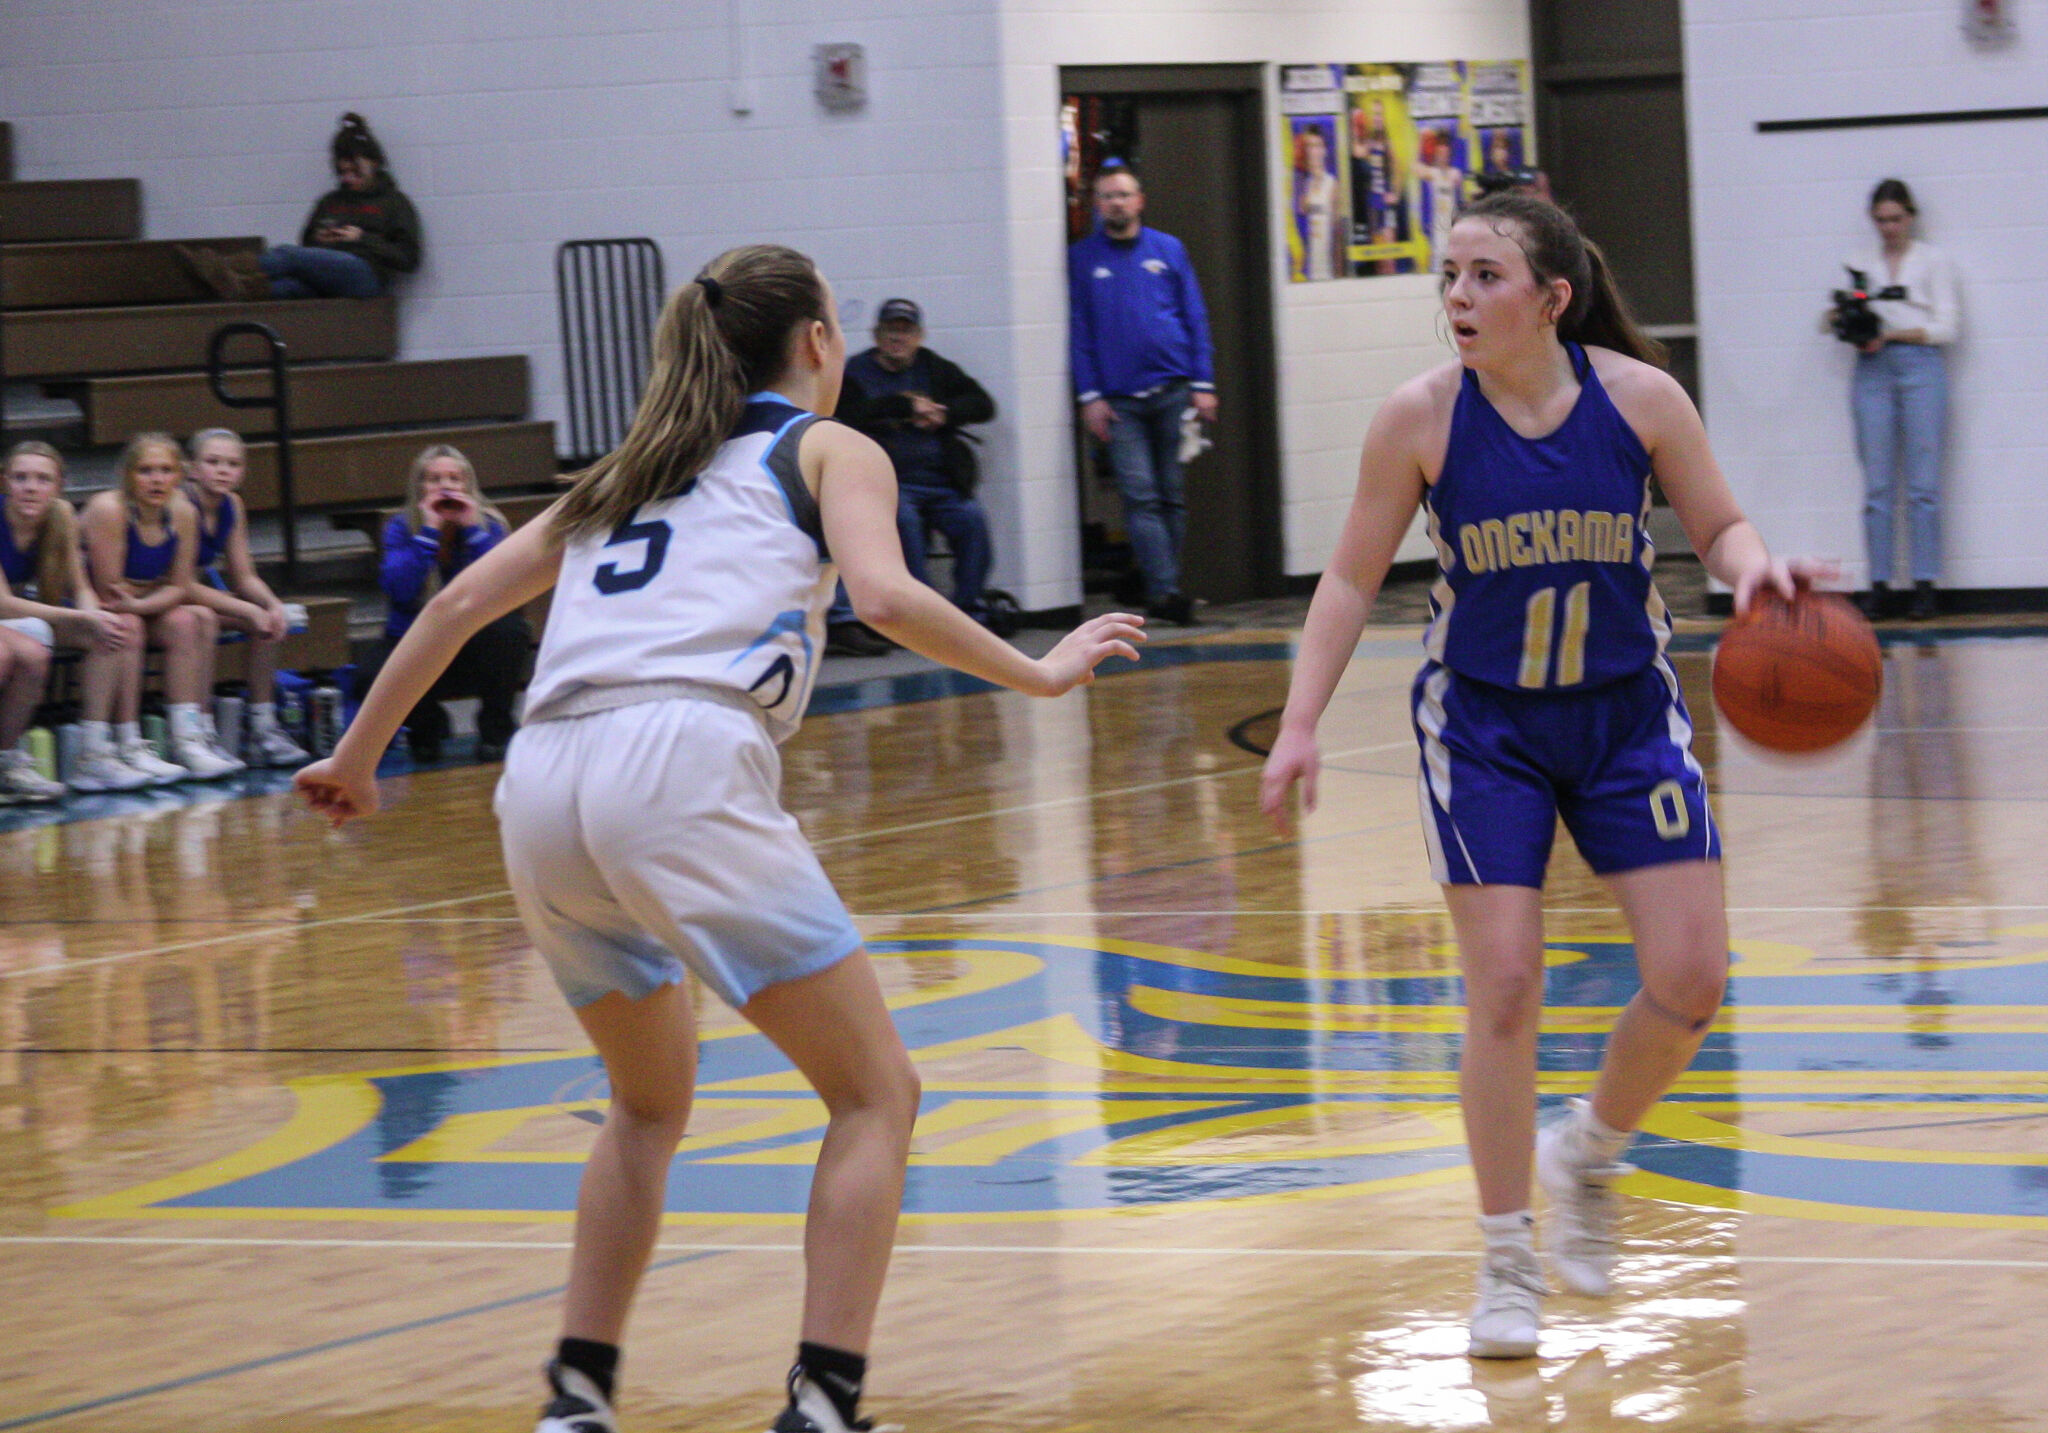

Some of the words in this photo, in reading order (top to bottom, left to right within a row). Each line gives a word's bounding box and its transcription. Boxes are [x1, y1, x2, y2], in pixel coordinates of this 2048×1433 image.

[592, 478, 697, 595] 5
[1459, 510, 1634, 575] ONEKAMA
[1516, 581, 1592, 690] 11
